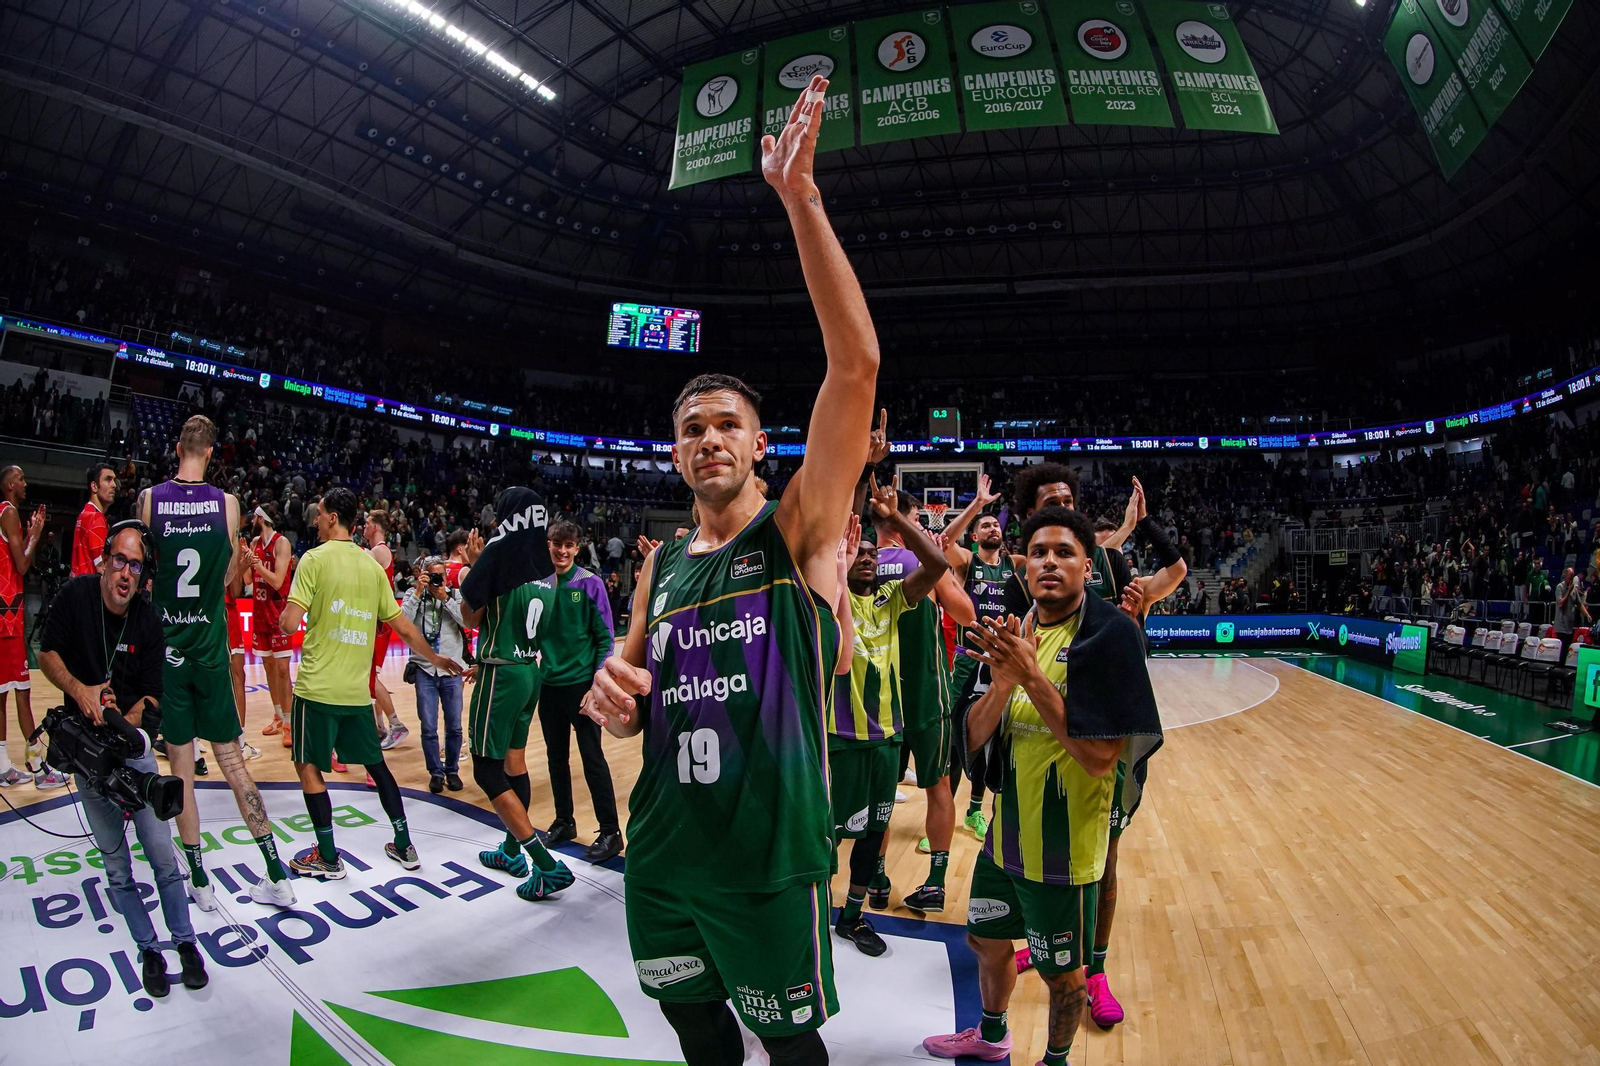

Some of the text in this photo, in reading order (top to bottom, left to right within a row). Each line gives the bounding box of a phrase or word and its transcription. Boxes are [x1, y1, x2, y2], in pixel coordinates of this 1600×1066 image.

[980, 41, 1026, 53] EuroCup
[964, 69, 1056, 91] CAMPEONES
[1068, 69, 1159, 88] CAMPEONES
[1173, 71, 1259, 92] CAMPEONES
[862, 78, 951, 105] CAMPEONES
[972, 86, 1052, 102] EUROCUP
[1069, 85, 1162, 97] COPA DEL REY
[1211, 92, 1237, 104] BCL
[887, 96, 929, 115] ACB
[984, 100, 1044, 114] 2016/2017
[1106, 100, 1136, 111] 2023
[1211, 104, 1242, 116] 2024
[764, 108, 851, 135] COP REY
[877, 109, 940, 127] 2005/2006
[676, 117, 752, 151] CAMPEONES
[677, 133, 748, 159] COPA KORAC
[685, 150, 737, 172] 2000/2001
[185, 359, 208, 374] 18:00
[284, 379, 323, 397] Unicaja VS
[431, 413, 450, 425] 18:00
[933, 410, 947, 418] 0.3
[510, 428, 545, 441] Unicaja VS
[1364, 431, 1384, 441] 18:00
[889, 444, 908, 452] 8:00
[977, 441, 1016, 450] Unicaja VS
[1131, 440, 1153, 449] 18:00
[1221, 438, 1258, 448] Unicaja VS
[176, 548, 201, 598] 2
[734, 561, 748, 572] liga
[734, 563, 763, 576] endesa
[344, 605, 373, 621] Unicaja
[525, 598, 544, 640] 0
[677, 612, 767, 650] Unicaja
[1146, 627, 1210, 638] nicaja baloncesto
[1239, 627, 1301, 639] unicajabaloncesto
[1385, 631, 1422, 655] ¡Síguenos!
[1040, 726, 1052, 734] SO
[677, 727, 721, 784] 19
[736, 984, 765, 997] sabor
[789, 989, 808, 999] acb
[744, 994, 782, 1011] má
[742, 1000, 784, 1024] laga
